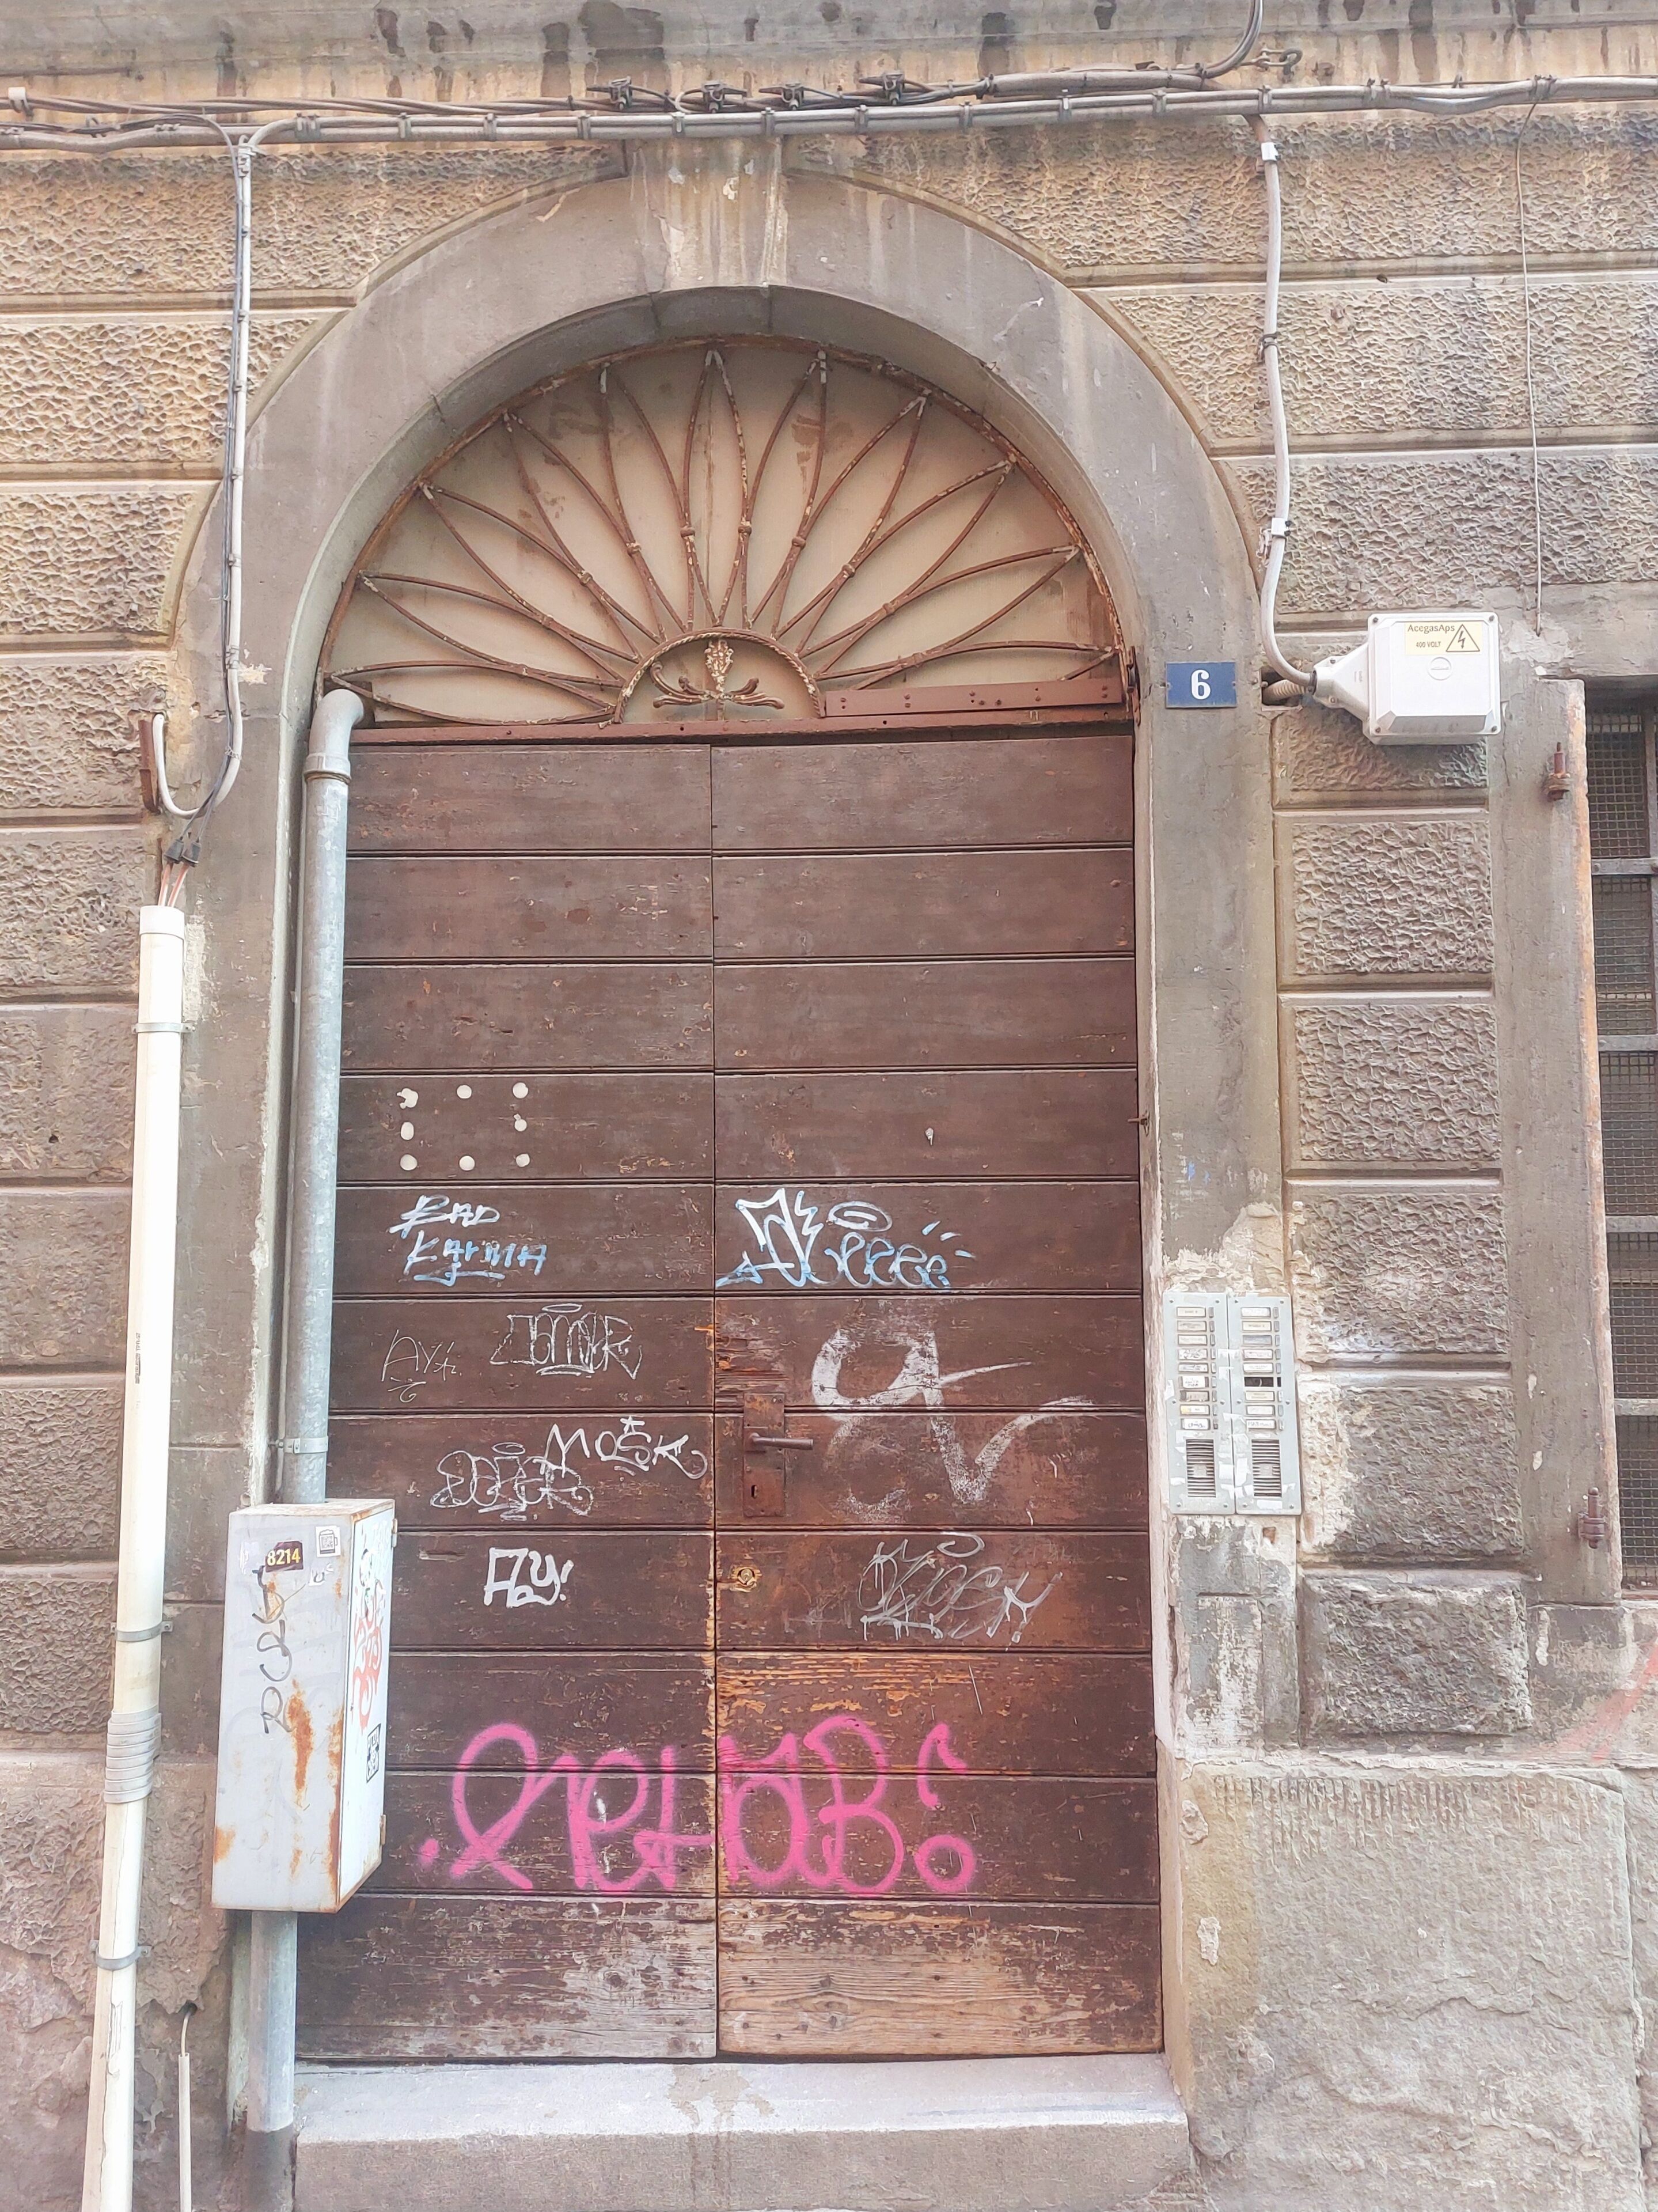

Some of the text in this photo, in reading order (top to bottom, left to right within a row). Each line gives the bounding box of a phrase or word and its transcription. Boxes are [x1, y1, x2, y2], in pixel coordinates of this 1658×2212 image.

[1407, 624, 1455, 634] AcegasAps
[1190, 668, 1211, 700] 6
[267, 1547, 302, 1566] 8214
